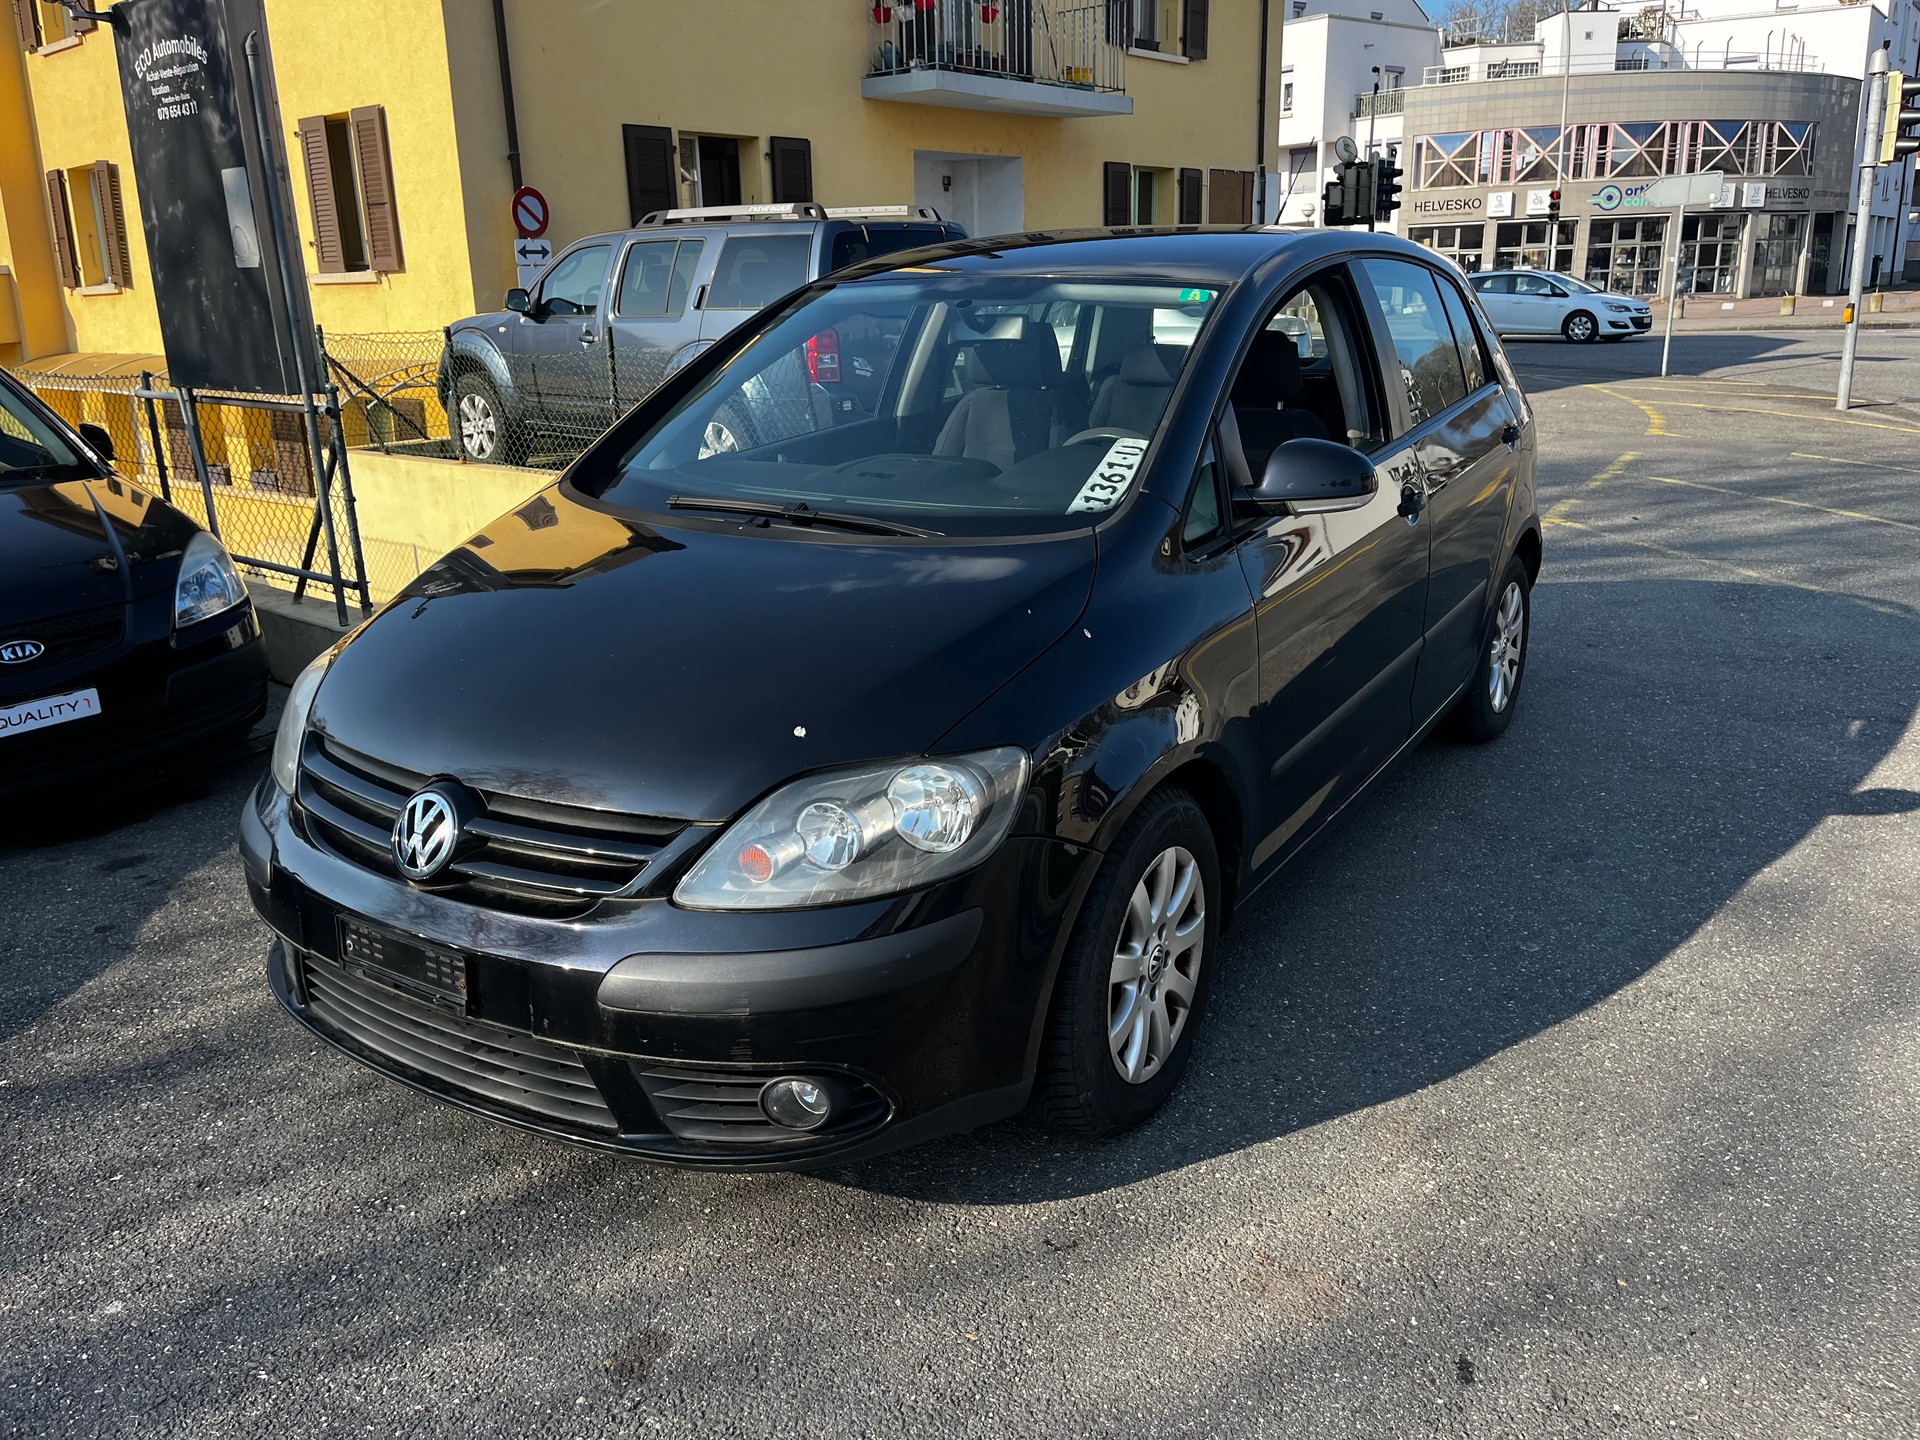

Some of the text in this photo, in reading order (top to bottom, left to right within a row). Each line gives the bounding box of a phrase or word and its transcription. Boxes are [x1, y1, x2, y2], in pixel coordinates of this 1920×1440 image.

[134, 34, 208, 80] ECO Automobiles
[157, 106, 170, 121] 079
[182, 102, 190, 116] 43
[1625, 183, 1649, 196] ort
[1765, 187, 1810, 199] HELVESKO
[748, 204, 792, 213] PATHFINDER
[1414, 197, 1482, 213] HELVESKO
[1, 644, 37, 660] KIA
